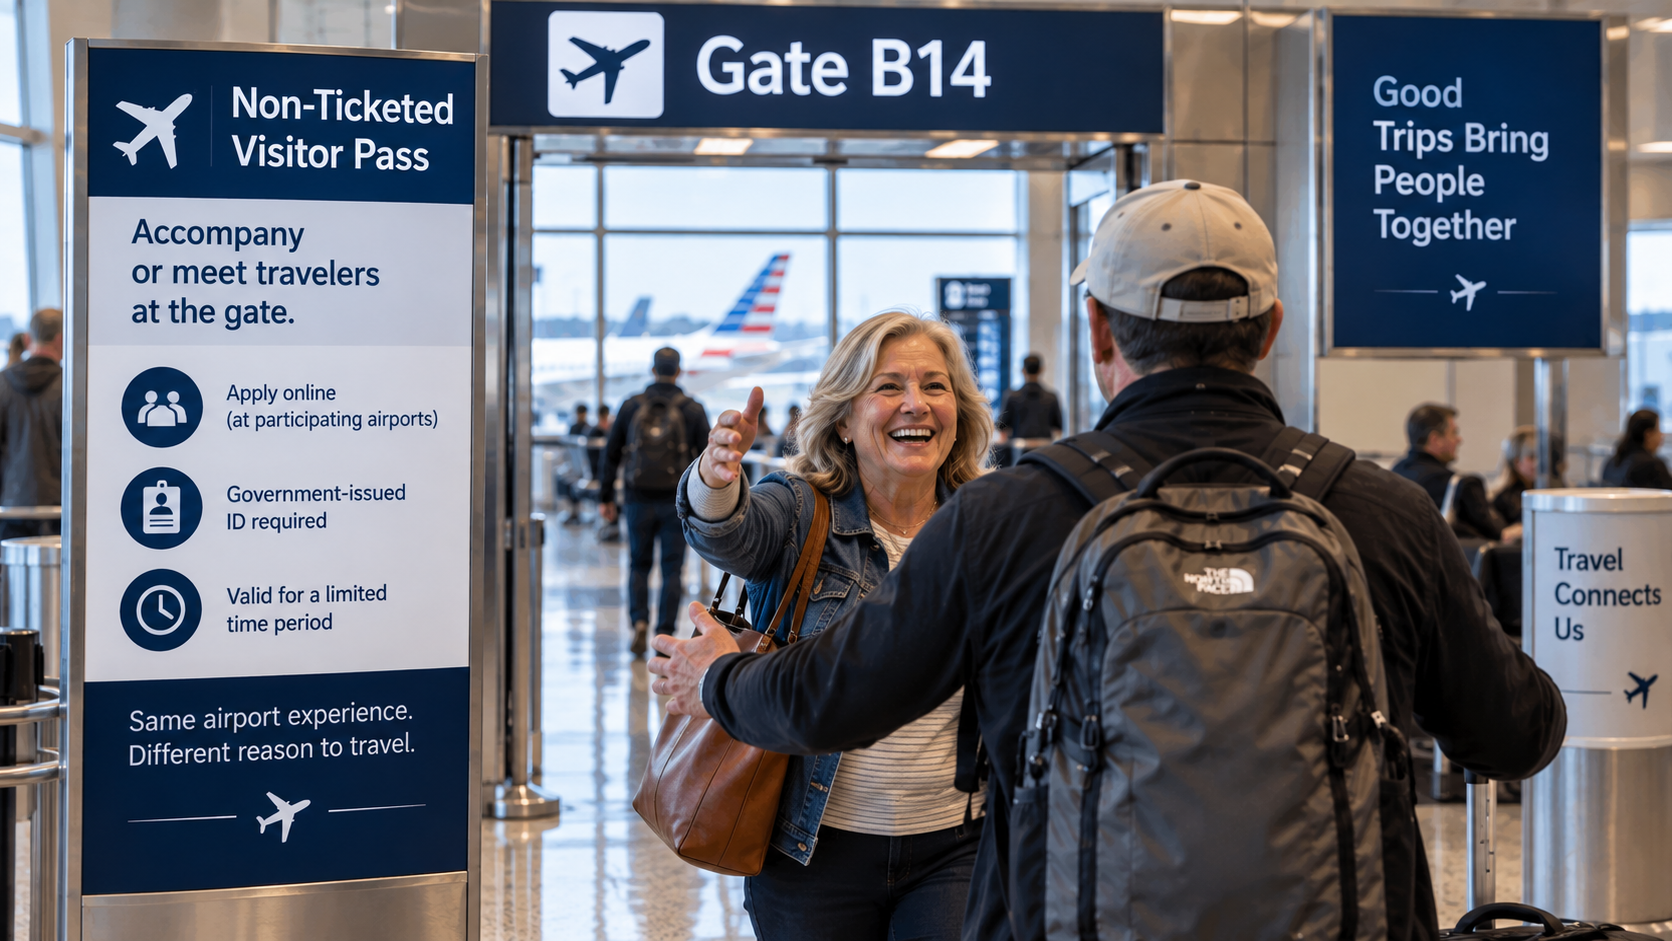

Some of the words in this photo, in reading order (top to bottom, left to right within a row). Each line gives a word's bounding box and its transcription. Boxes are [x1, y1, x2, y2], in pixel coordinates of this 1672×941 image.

[696, 34, 848, 96] Gate
[872, 38, 991, 97] B14
[232, 85, 453, 124] Non-Ticketed
[1373, 75, 1462, 108] Good
[231, 134, 343, 168] Visitor
[354, 137, 429, 171] Pass
[1372, 119, 1453, 159] Trips
[1465, 122, 1548, 161] Bring
[1374, 164, 1484, 203] People
[131, 218, 304, 252] Accompany
[1372, 208, 1516, 247] Together
[131, 264, 163, 284] or
[172, 260, 247, 284] meet
[255, 259, 379, 286] travelers
[131, 299, 159, 323] at
[167, 296, 215, 323] the
[224, 300, 294, 330] gate.
[226, 383, 278, 405] Apply
[282, 383, 336, 400] online
[226, 410, 249, 430] (at
[255, 410, 362, 431] participating
[367, 409, 437, 430] airports)
[226, 483, 405, 502] Government-issued
[227, 512, 245, 530] ID
[251, 511, 326, 533] required
[1554, 546, 1623, 571] Travel
[226, 585, 272, 604] Valid
[277, 585, 304, 603] for
[309, 589, 319, 603] a
[326, 583, 386, 602] limited
[1554, 581, 1662, 606] Connects
[226, 614, 268, 632] time
[274, 611, 332, 635] period
[1554, 616, 1584, 641] Us
[129, 709, 195, 731] Same
[203, 706, 280, 733] airport
[287, 701, 412, 729] experience.
[129, 742, 230, 766] Different
[238, 742, 312, 761] reason
[319, 737, 342, 757] to
[349, 731, 414, 755] travel.
